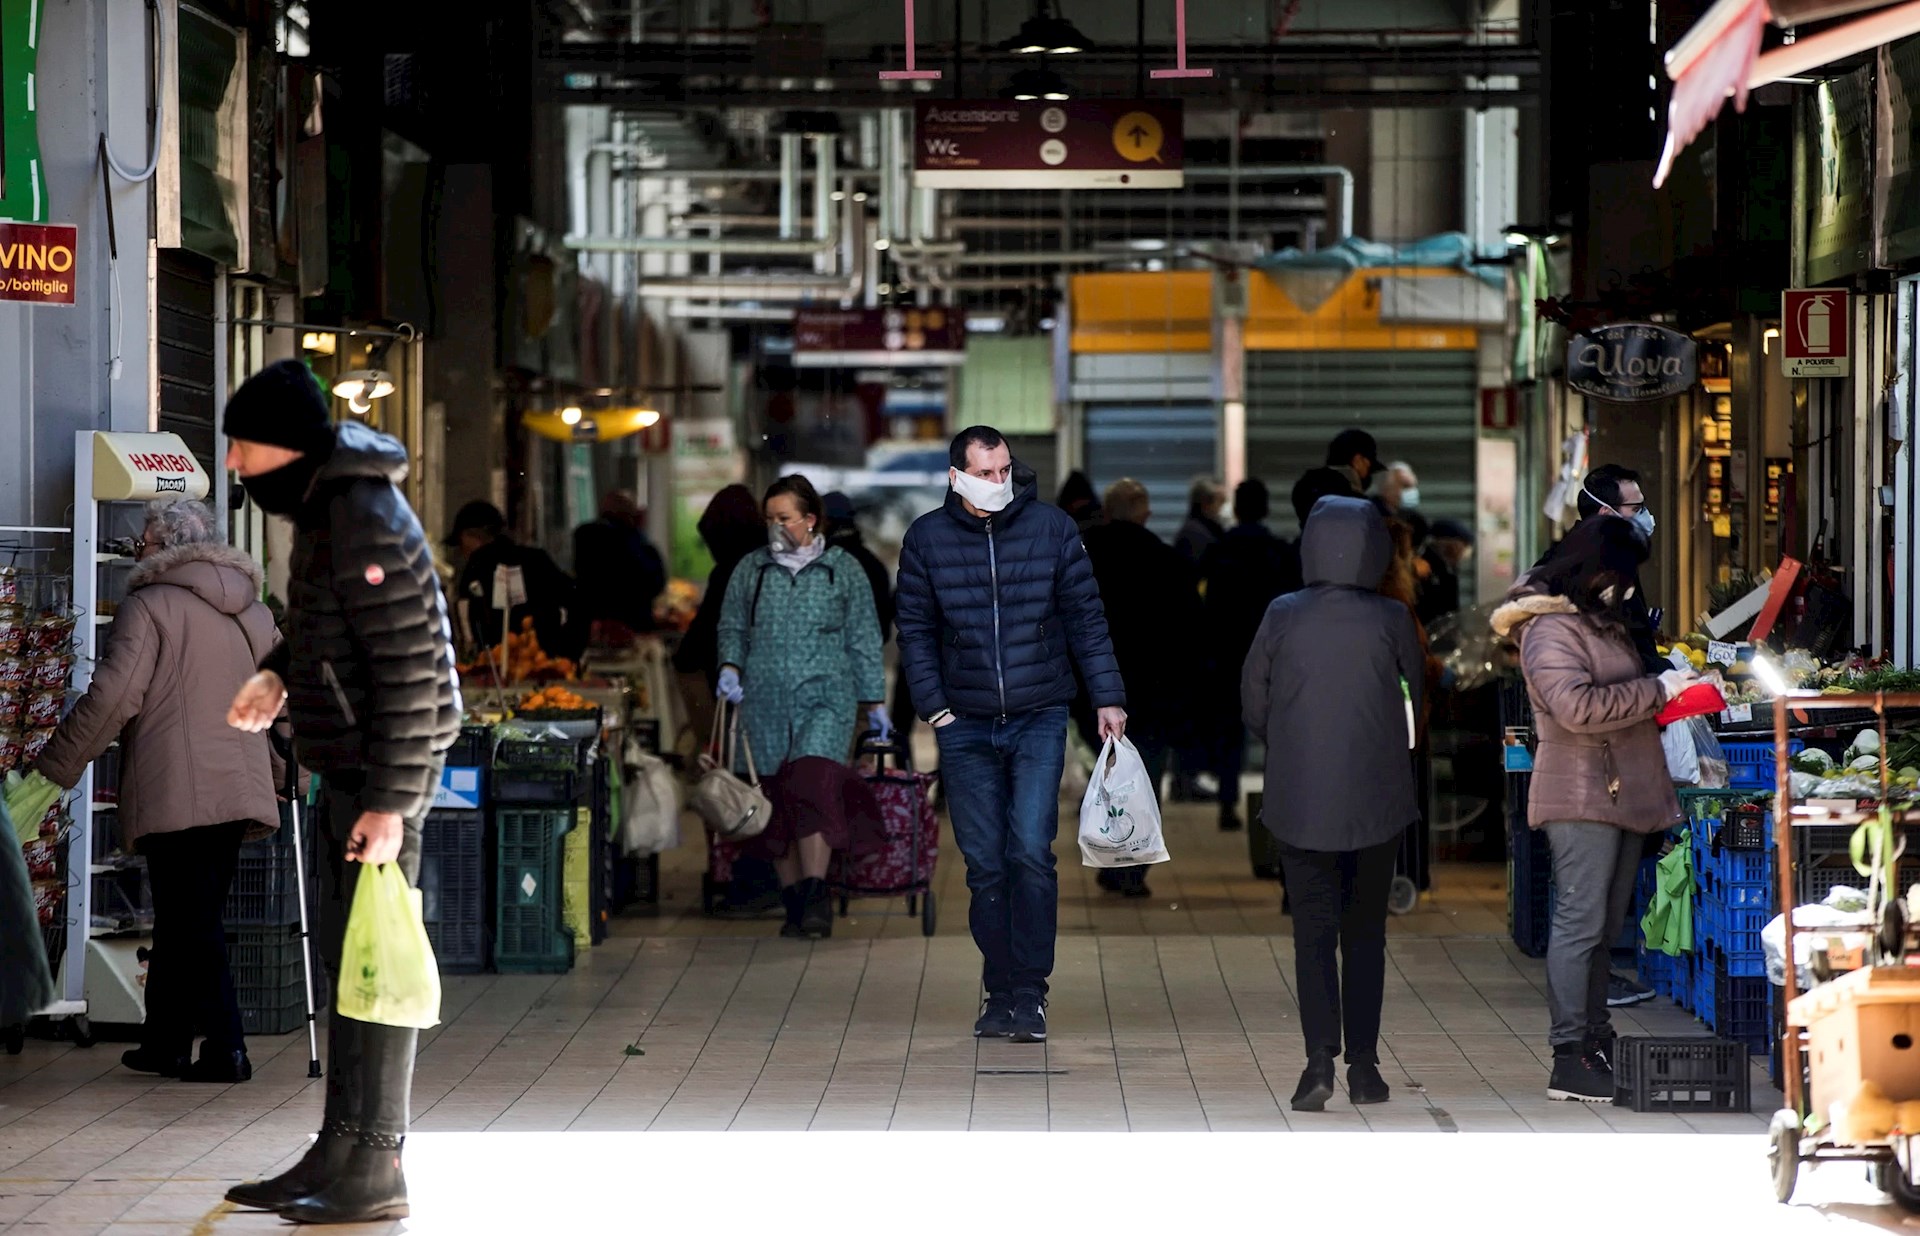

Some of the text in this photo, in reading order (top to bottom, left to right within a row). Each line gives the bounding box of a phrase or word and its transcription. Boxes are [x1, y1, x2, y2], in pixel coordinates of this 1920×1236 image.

[925, 106, 1020, 123] Ascensore
[925, 139, 961, 156] Wc
[0, 243, 73, 273] VINO
[1578, 343, 1683, 377] Uova
[1805, 358, 1835, 366] POLVERE
[1791, 367, 1802, 376] N.
[128, 453, 195, 473] HARIBO
[157, 478, 185, 493] MAOAM
